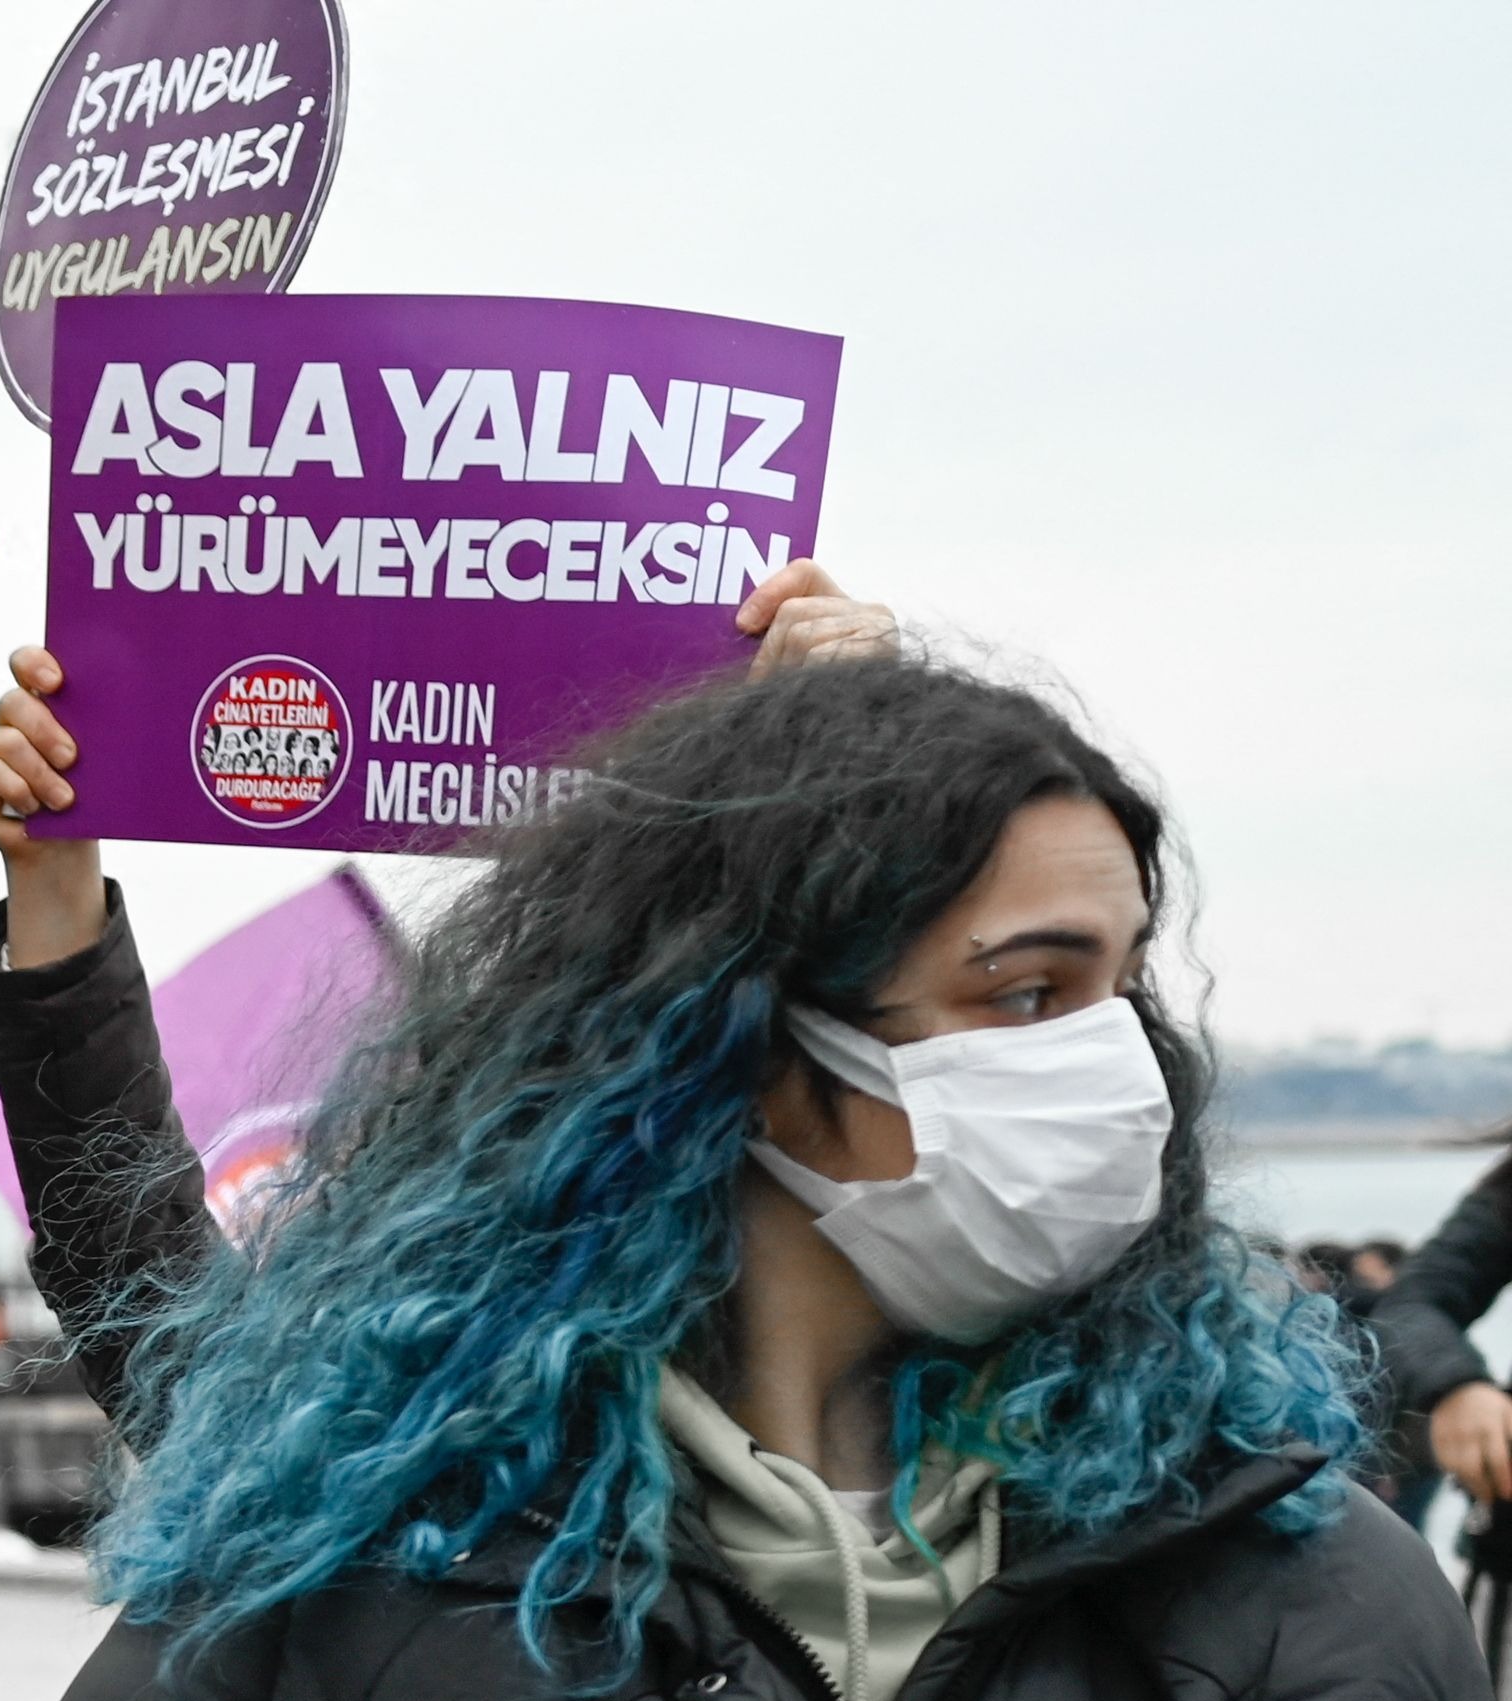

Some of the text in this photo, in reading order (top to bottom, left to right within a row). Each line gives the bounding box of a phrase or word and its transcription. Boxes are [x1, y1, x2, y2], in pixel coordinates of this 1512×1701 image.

[66, 40, 291, 137] İSTANBUL
[26, 95, 315, 227] SÖZLEŞMESİ
[1, 212, 295, 313] UYGULANSIN
[72, 359, 805, 502] ASLA YALNIZ
[72, 493, 791, 606] YÜRÜMEYECEKSİN
[214, 698, 329, 726] CİNAYETLERİNİ
[229, 676, 317, 702] KADIN
[370, 680, 496, 746] KADIN
[216, 777, 322, 802] DURDURACAĞIZ
